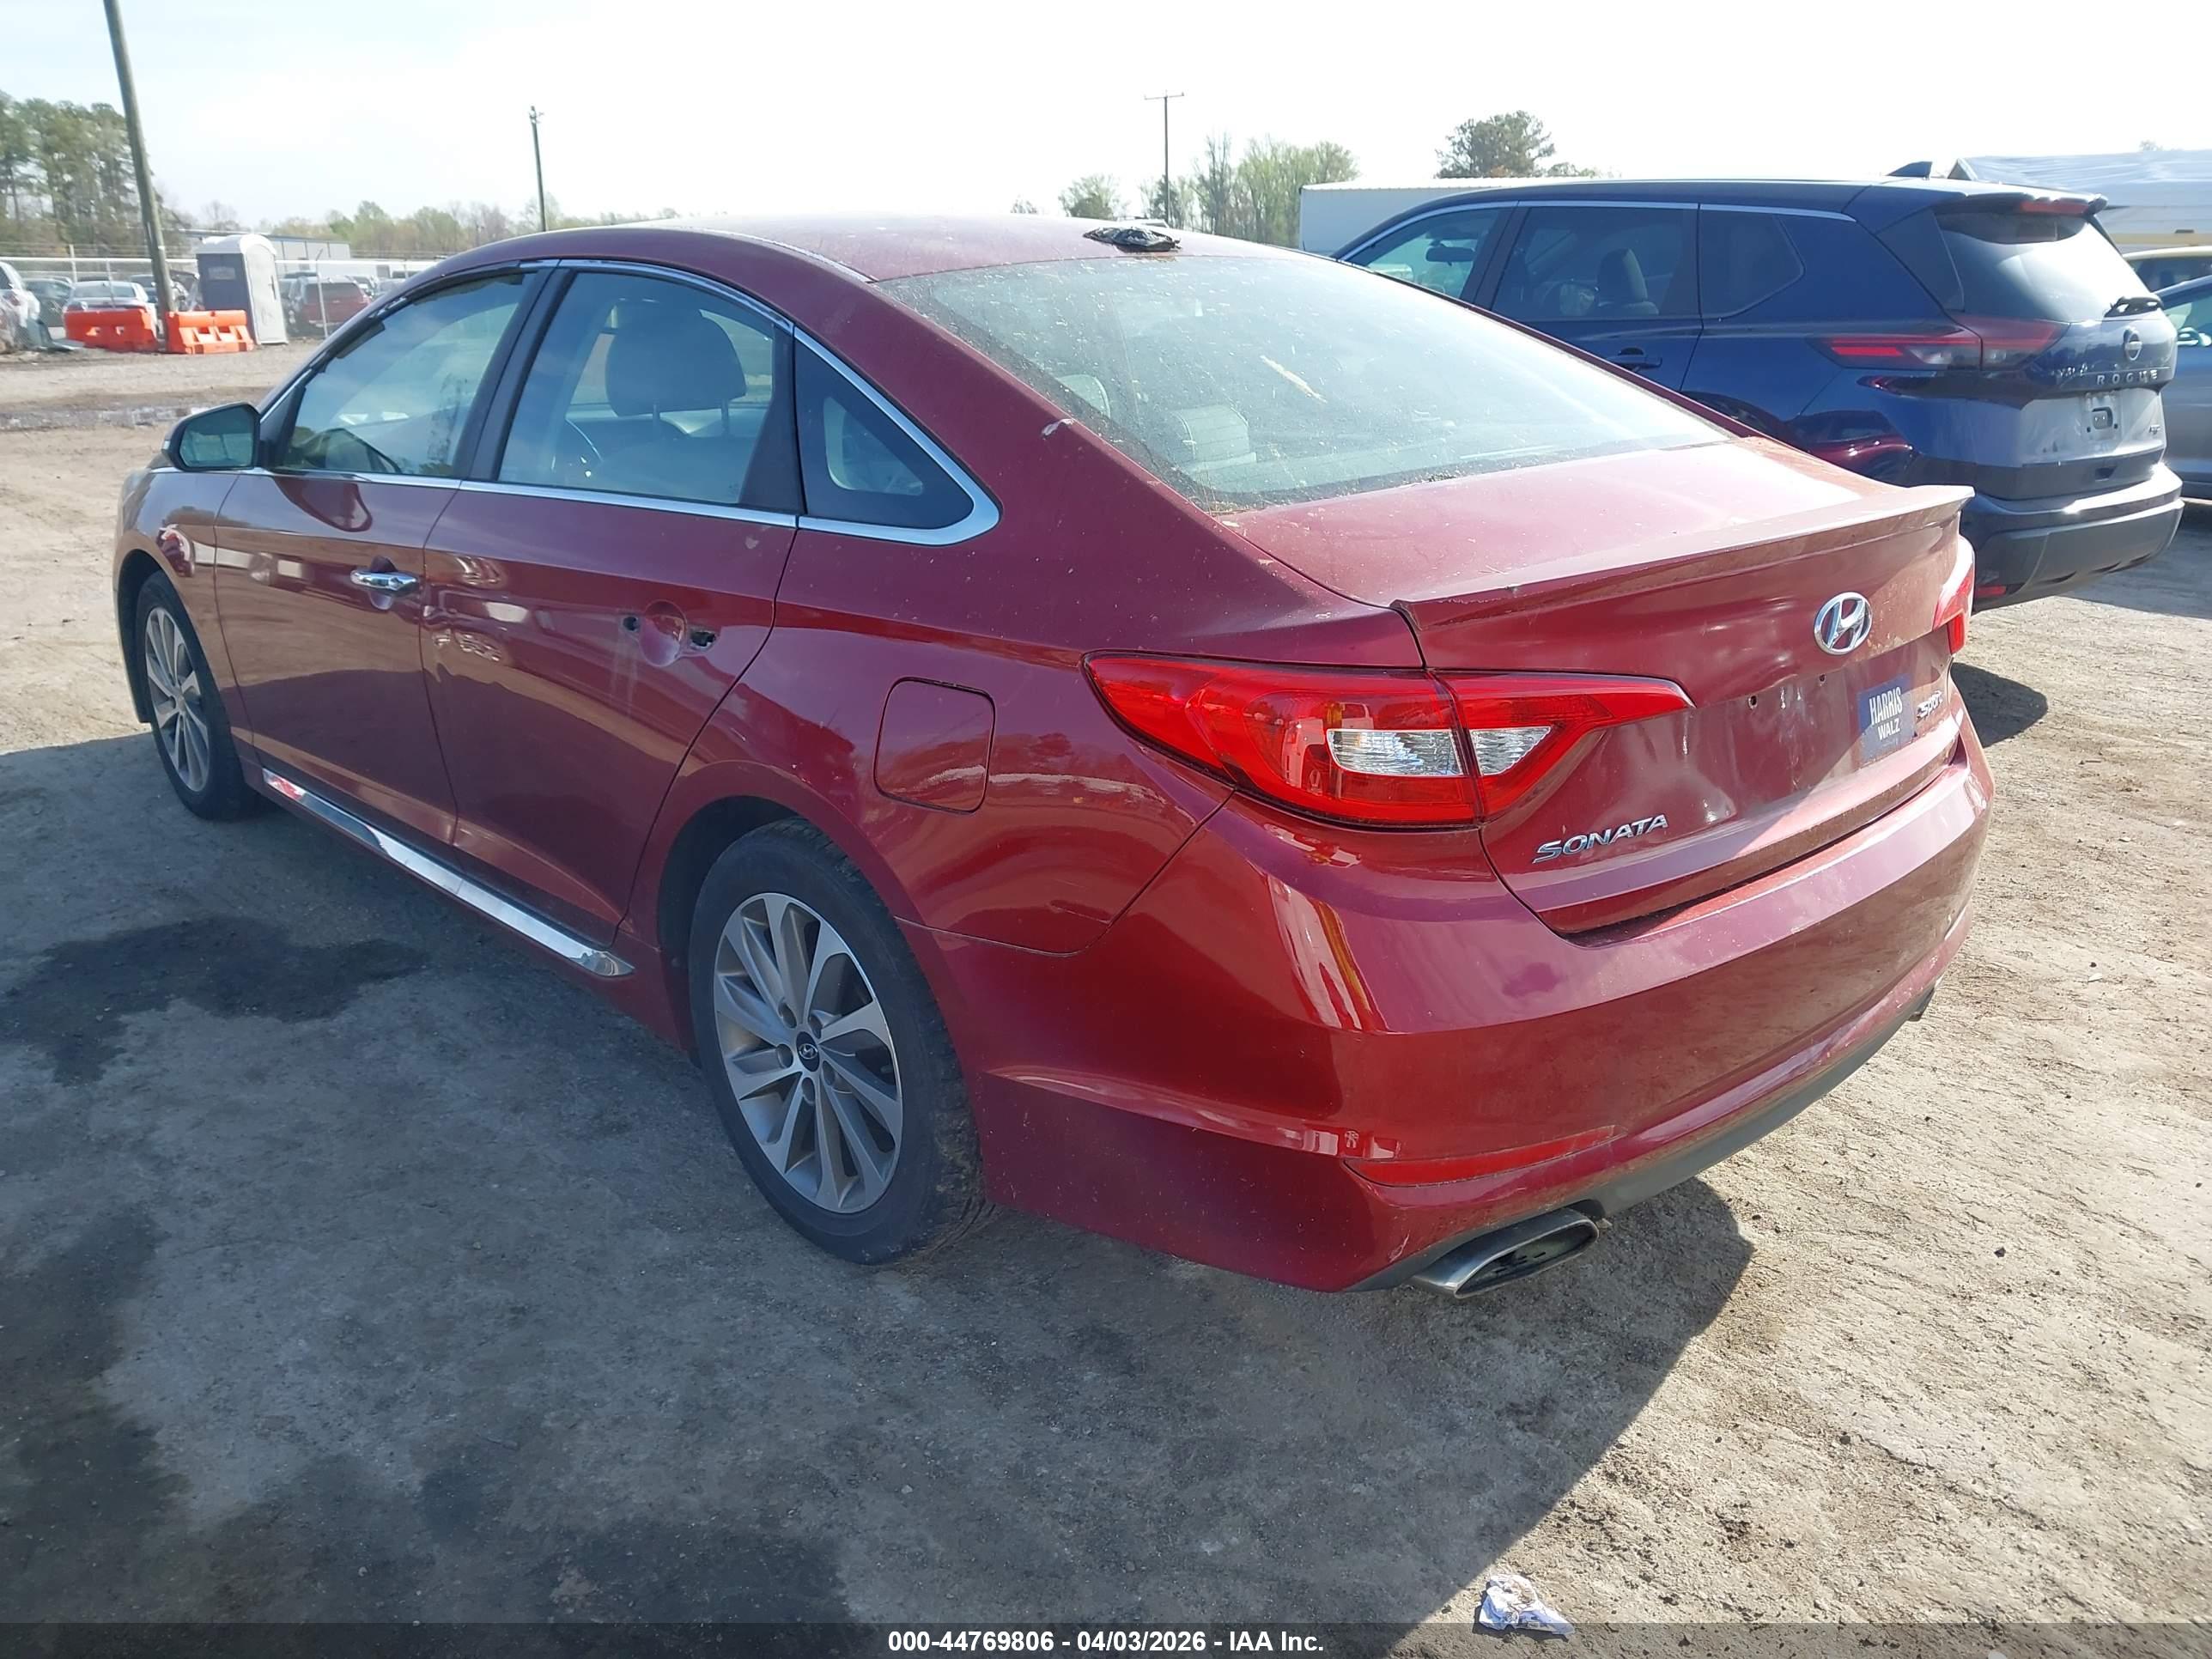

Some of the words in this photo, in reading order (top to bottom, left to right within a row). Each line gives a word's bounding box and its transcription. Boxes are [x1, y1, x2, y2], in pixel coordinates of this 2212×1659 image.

[2096, 369, 2158, 385] ROGUE
[1869, 686, 1903, 725] HARRIS
[1877, 718, 1900, 740] WALZ
[1532, 814, 1668, 864] SONATA
